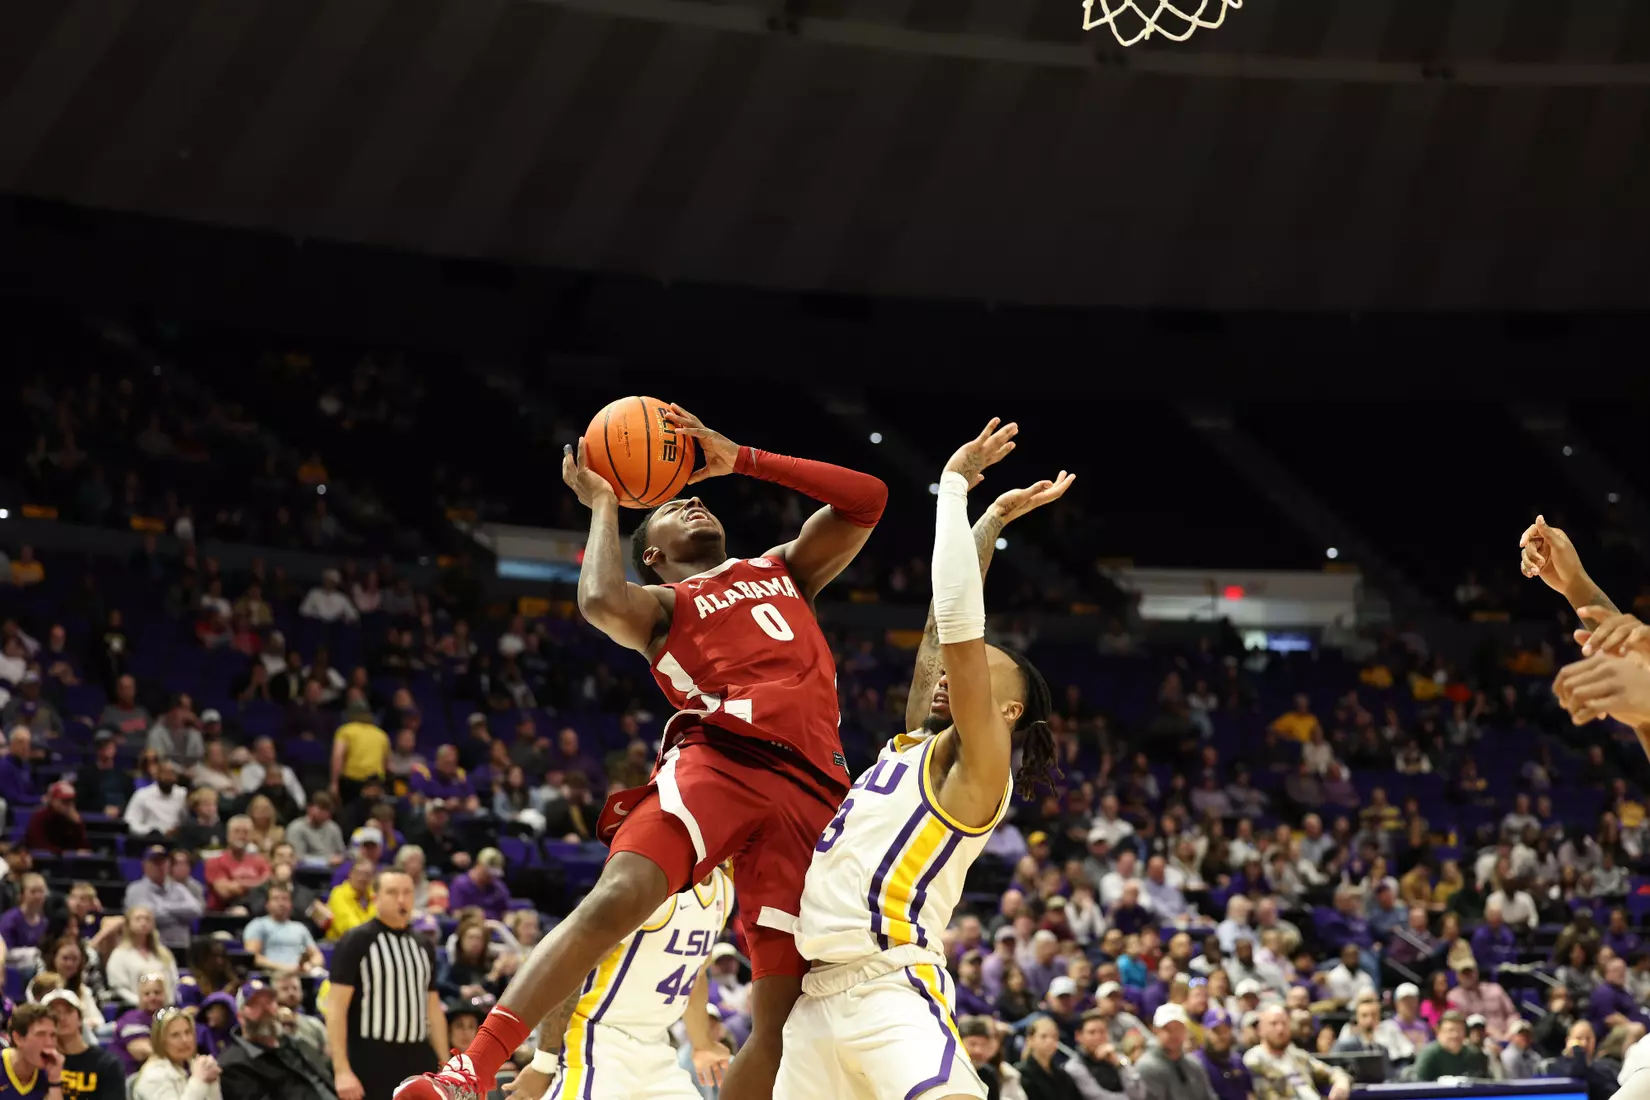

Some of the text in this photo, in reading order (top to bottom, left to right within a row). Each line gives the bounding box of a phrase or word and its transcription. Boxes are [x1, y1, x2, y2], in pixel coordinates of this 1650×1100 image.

[693, 576, 799, 619] ALABAMA
[751, 603, 795, 641] 0
[664, 929, 719, 956] LSU
